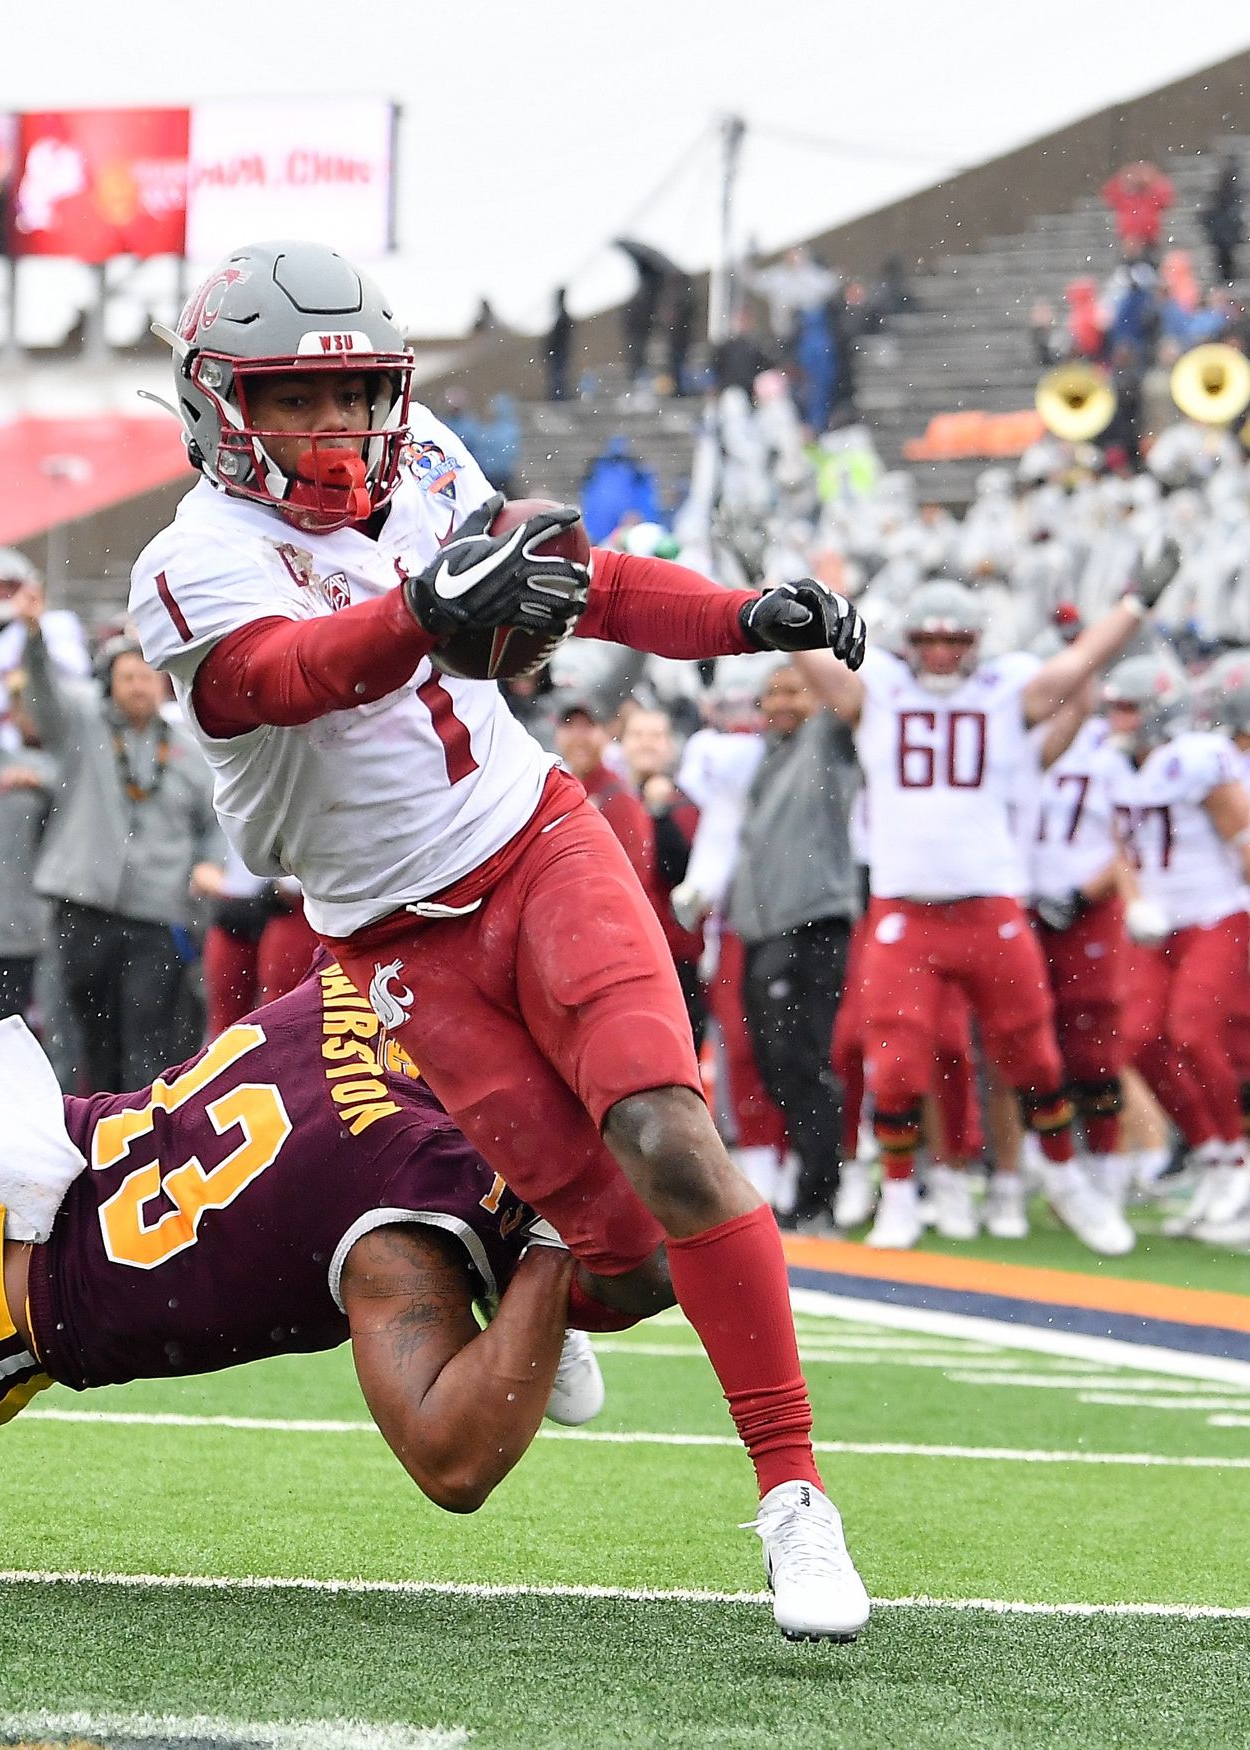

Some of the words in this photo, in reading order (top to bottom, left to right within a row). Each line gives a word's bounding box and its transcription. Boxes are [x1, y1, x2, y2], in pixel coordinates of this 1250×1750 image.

[318, 334, 354, 354] WSU
[154, 569, 195, 644] 1
[900, 711, 986, 788] 60
[91, 1023, 293, 1270] 13
[800, 1486, 811, 1507] VPR
